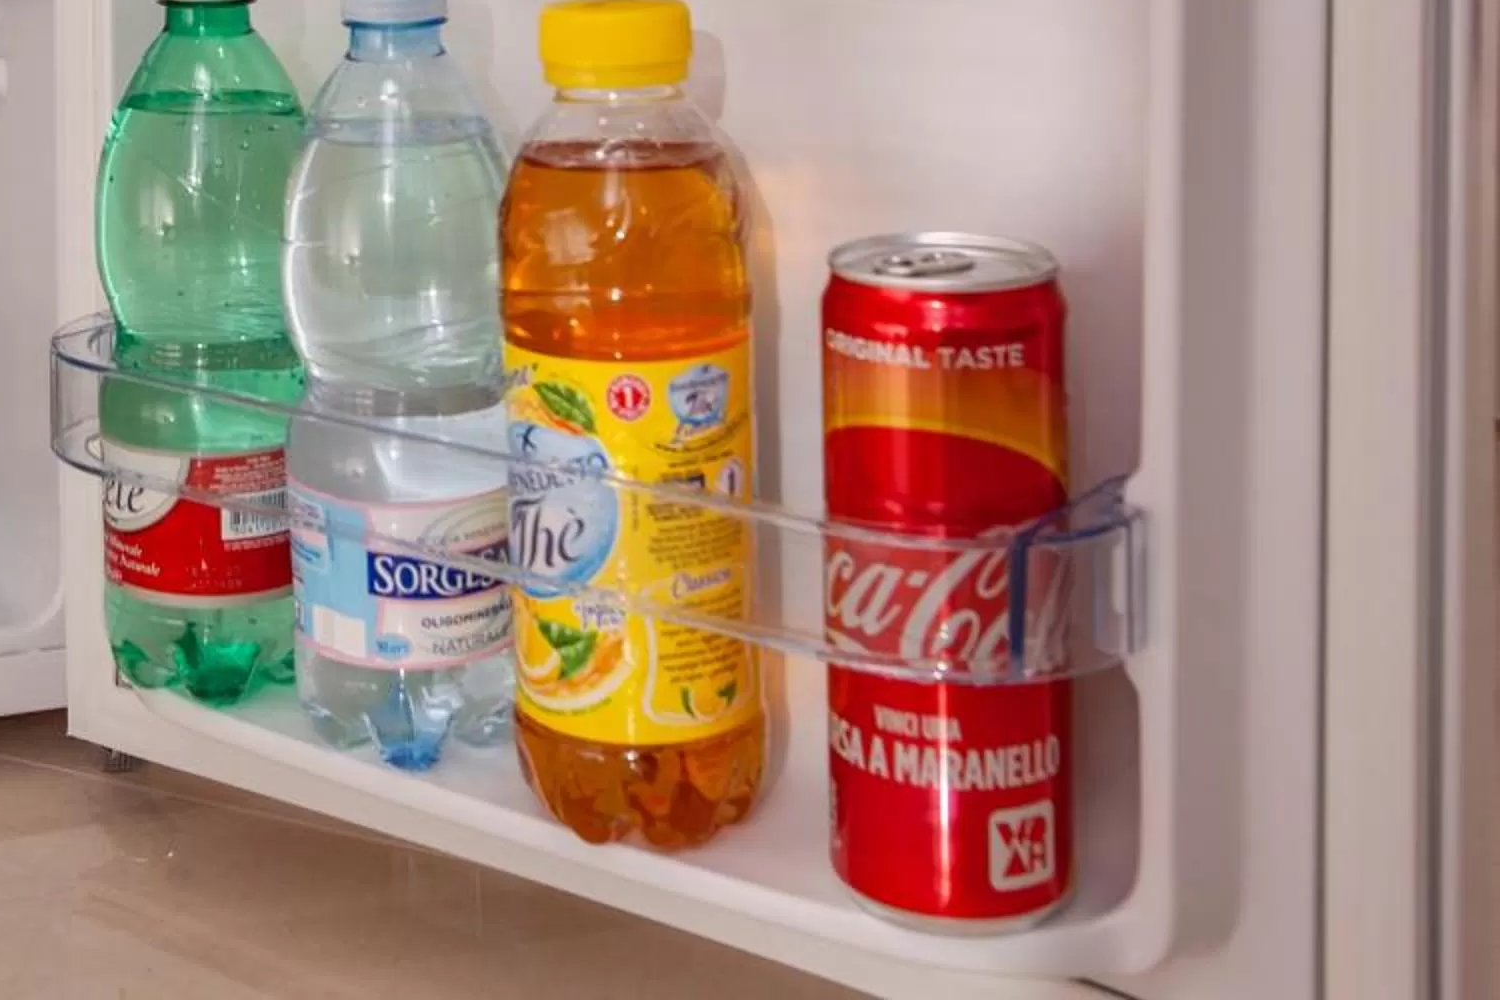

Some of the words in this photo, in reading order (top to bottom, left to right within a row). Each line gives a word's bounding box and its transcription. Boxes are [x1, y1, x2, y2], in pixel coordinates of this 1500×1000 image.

[826, 328, 931, 369] ORIGINAL
[936, 344, 1024, 369] TASTE
[873, 703, 919, 738] VINCI
[921, 714, 963, 742] UNA
[868, 734, 891, 779] A
[893, 733, 1060, 791] MARANELLO
